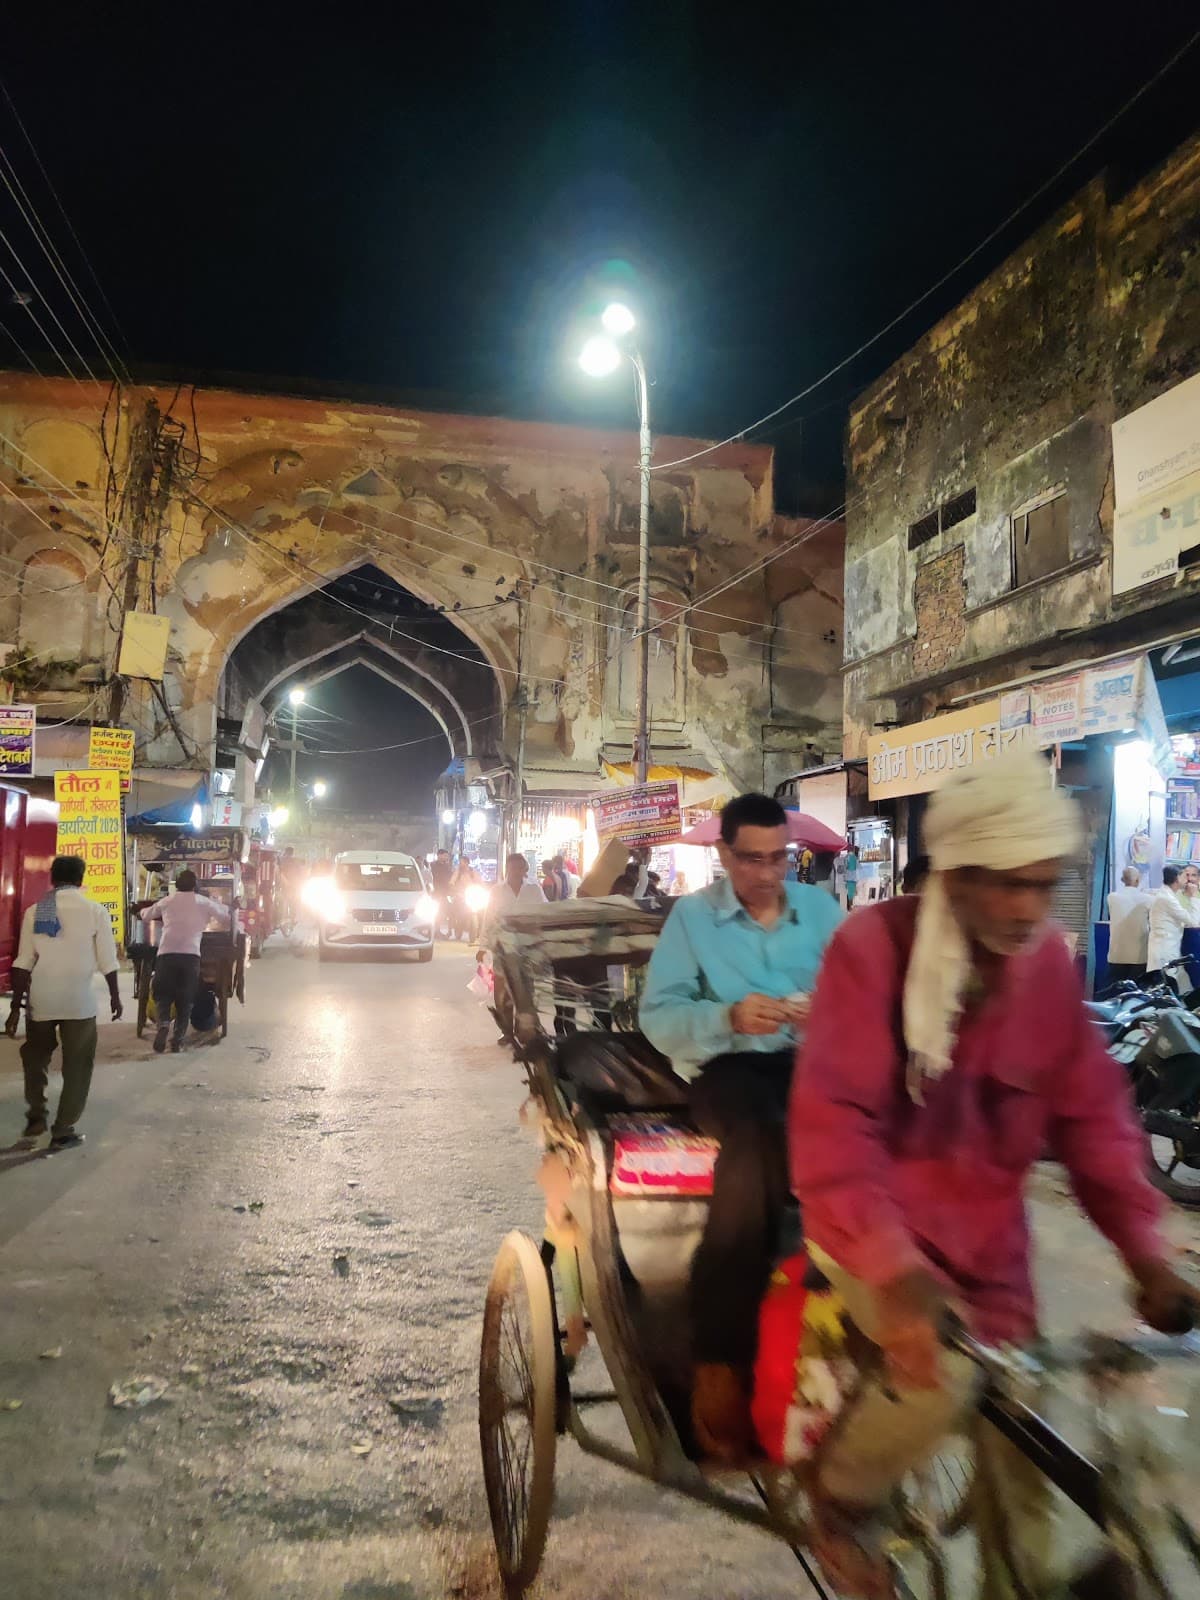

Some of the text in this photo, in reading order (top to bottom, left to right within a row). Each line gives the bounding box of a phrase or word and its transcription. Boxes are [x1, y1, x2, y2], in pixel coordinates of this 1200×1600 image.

[1043, 702, 1075, 715] NOTES
[872, 741, 908, 785] ओम
[912, 728, 975, 781] प्रकाश
[59, 773, 102, 793] तौल
[91, 837, 119, 861] कार्ड
